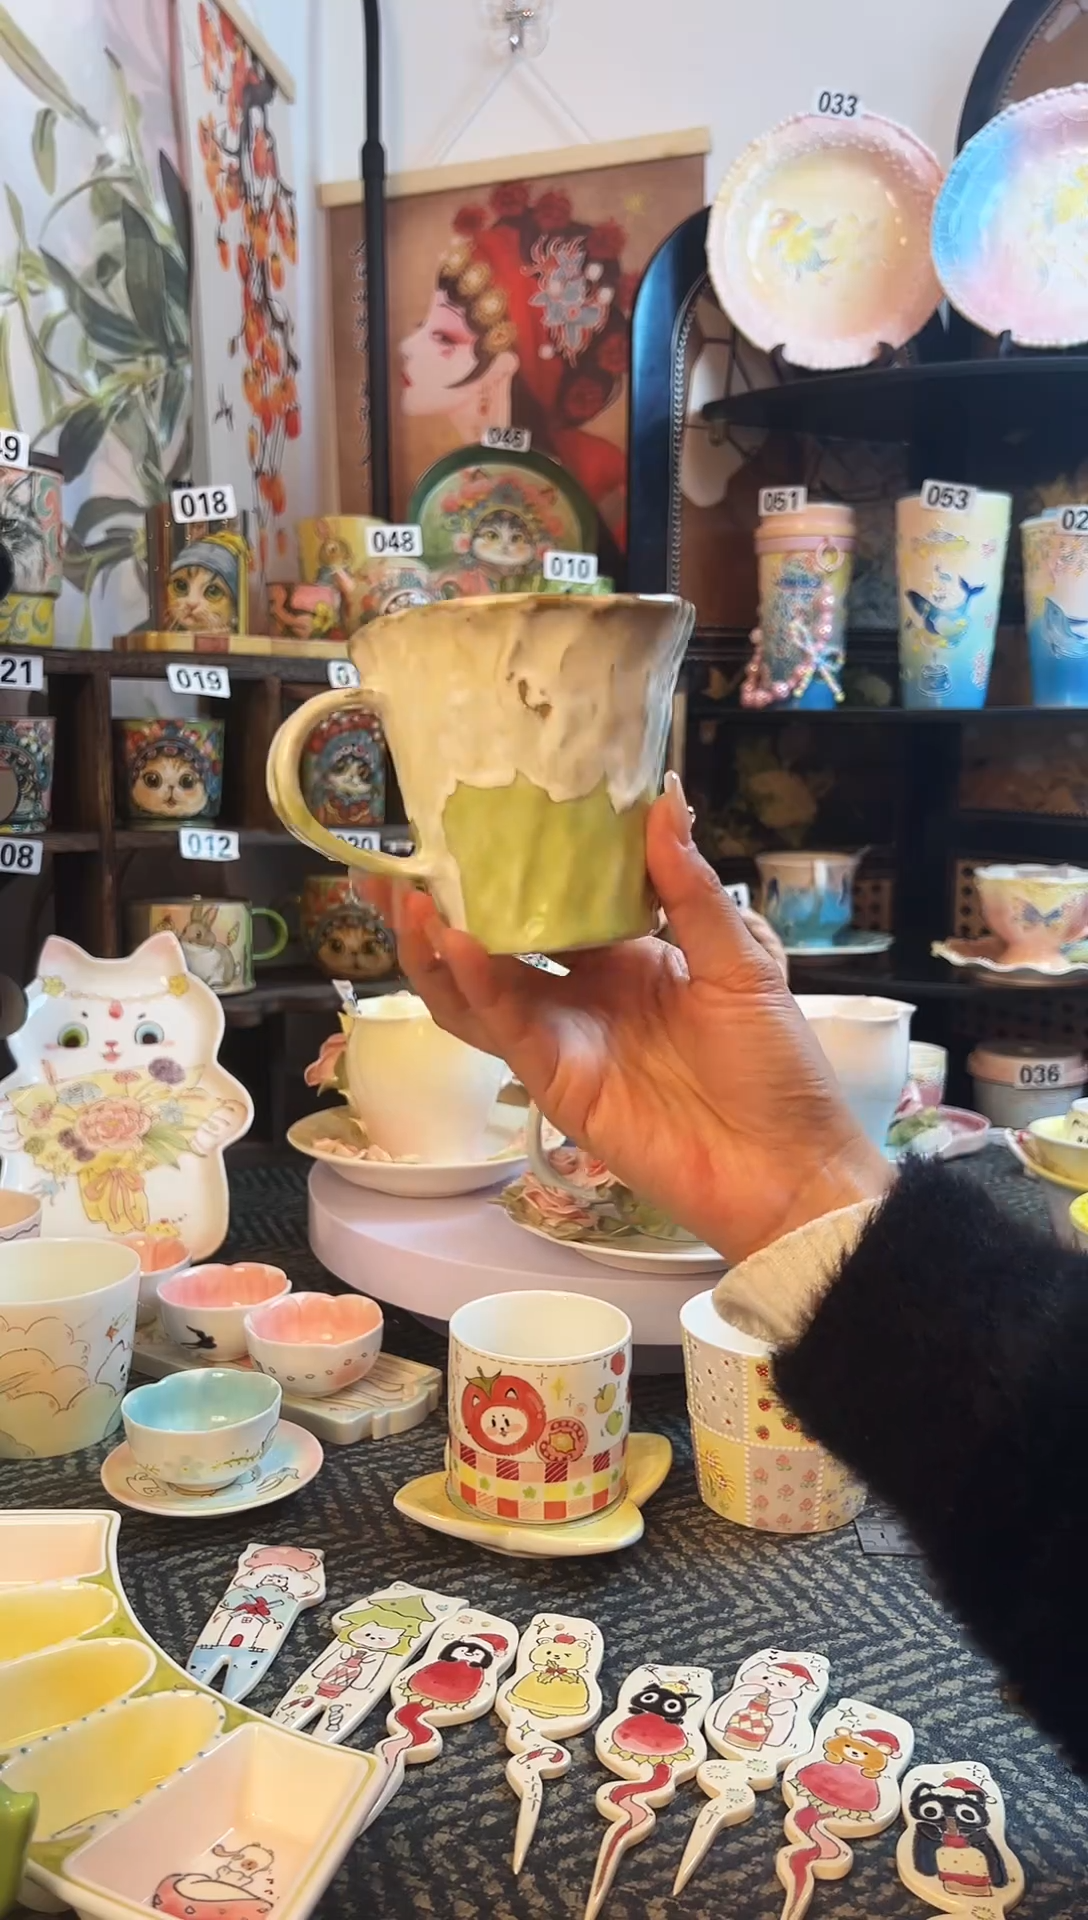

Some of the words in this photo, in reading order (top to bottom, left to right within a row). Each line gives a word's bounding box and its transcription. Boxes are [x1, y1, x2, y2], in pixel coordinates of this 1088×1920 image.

[819, 91, 858, 117] 033
[0, 436, 19, 462] 9
[180, 491, 227, 517] 018
[764, 491, 799, 512] 051
[927, 485, 969, 510] 053
[373, 531, 413, 552] 048
[551, 557, 590, 579] 010
[0, 657, 32, 684] 21
[176, 669, 222, 690] 019
[0, 843, 34, 869] 08
[188, 833, 232, 858] 012
[1020, 1063, 1059, 1083] 036
